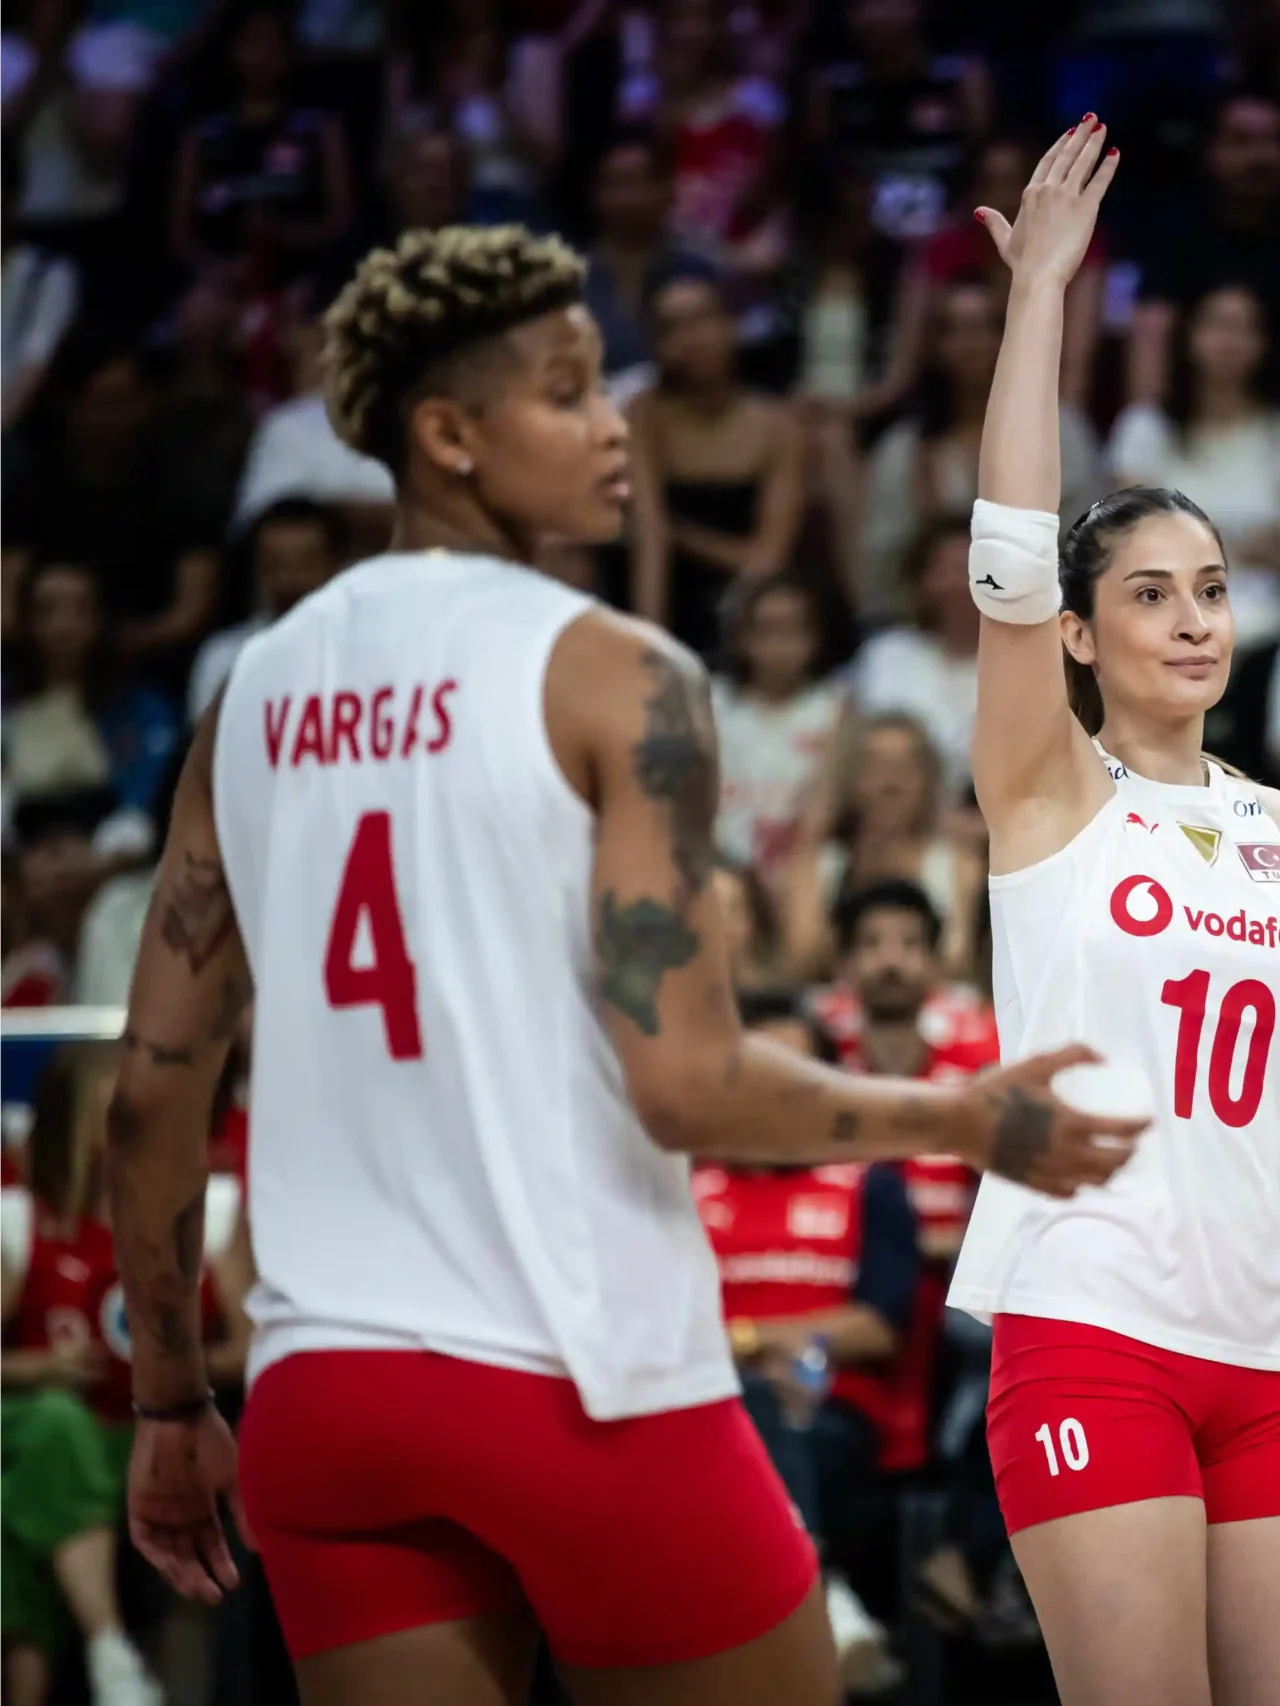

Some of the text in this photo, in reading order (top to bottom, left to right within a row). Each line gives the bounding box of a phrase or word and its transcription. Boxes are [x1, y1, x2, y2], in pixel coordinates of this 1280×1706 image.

[322, 809, 424, 1062] 4
[1160, 968, 1277, 1129] 10
[1035, 1417, 1090, 1477] 10
